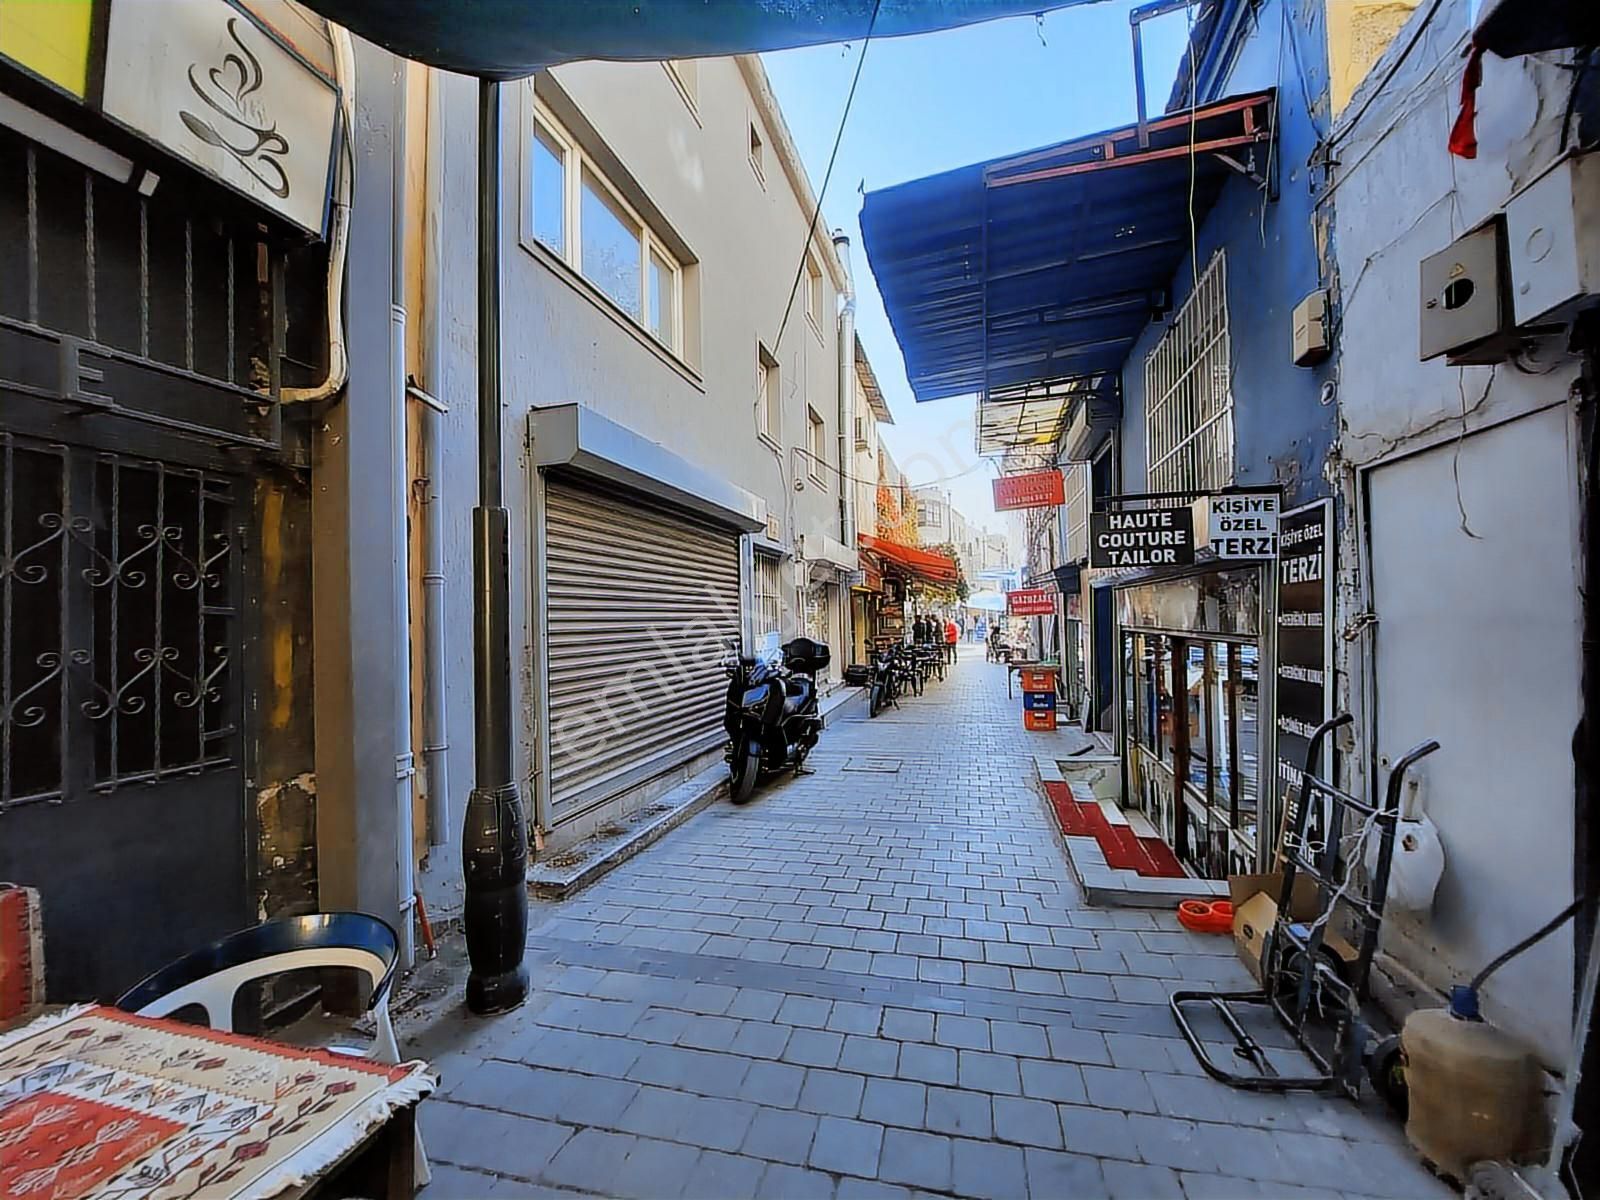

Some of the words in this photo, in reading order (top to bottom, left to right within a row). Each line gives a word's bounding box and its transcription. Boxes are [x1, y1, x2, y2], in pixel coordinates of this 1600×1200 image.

[1212, 498, 1275, 516] KİŞİYE
[1109, 512, 1172, 530] HAUTE
[1220, 516, 1268, 532] ÖZEL
[1098, 530, 1186, 549] COUTURE
[1304, 524, 1323, 541] ÖZEL
[1211, 533, 1279, 556] TERZİ
[1108, 549, 1176, 566] TAILOR
[1281, 545, 1322, 585] TERZİ
